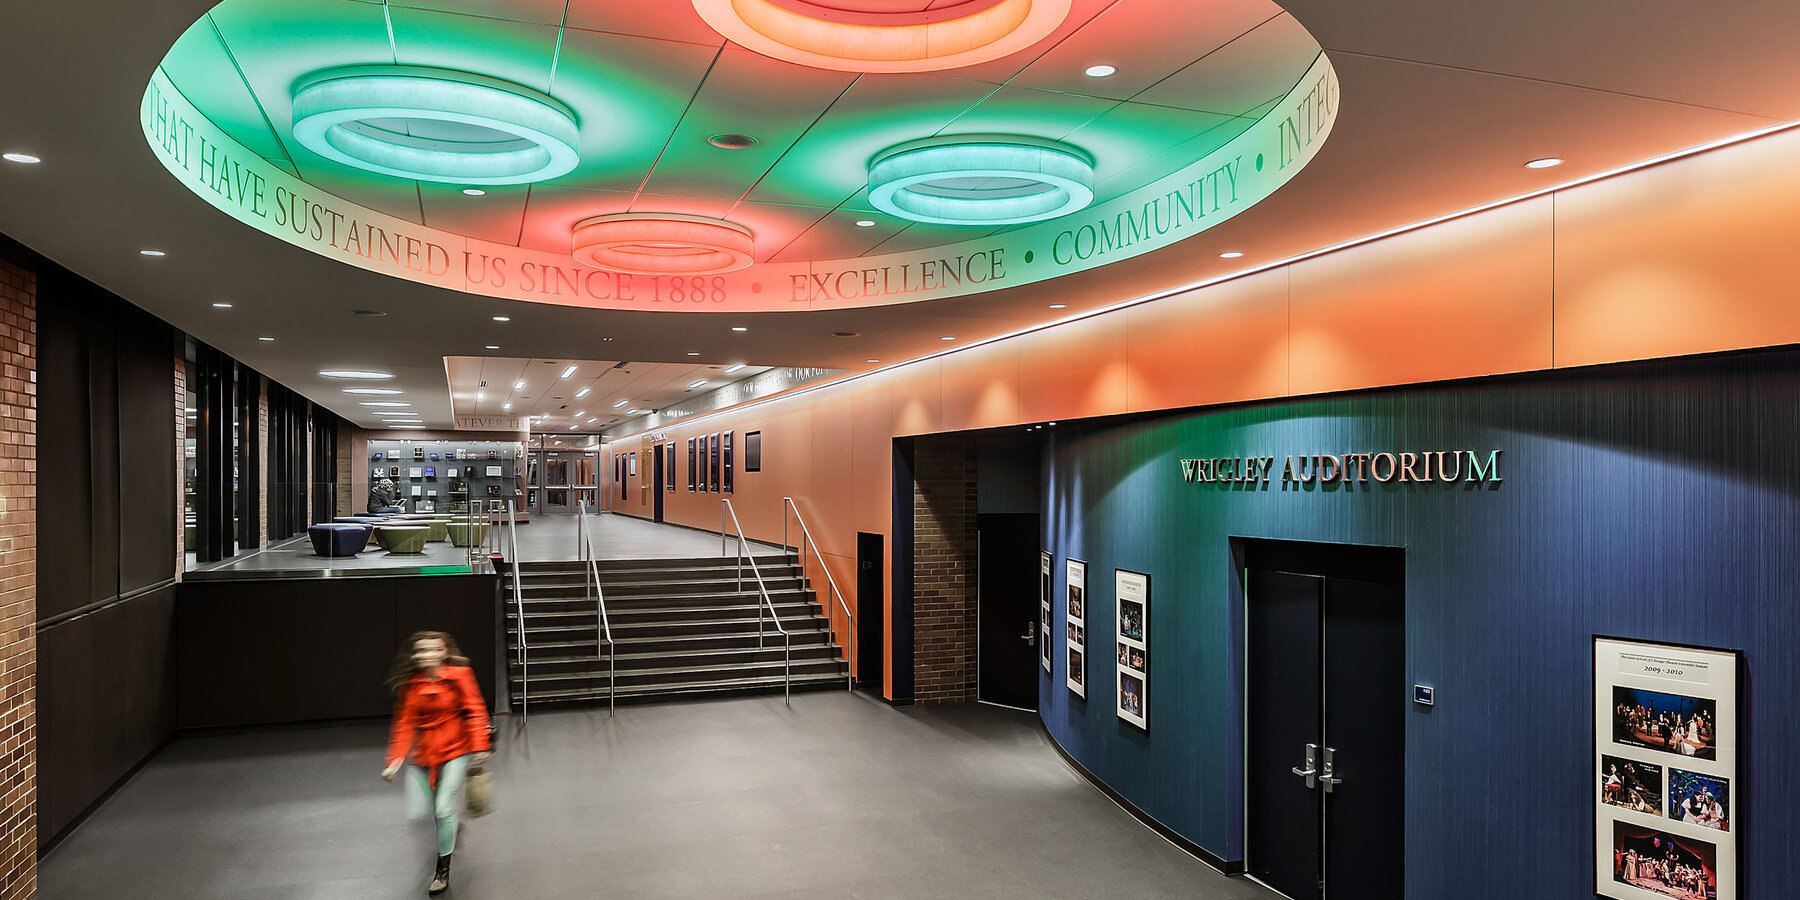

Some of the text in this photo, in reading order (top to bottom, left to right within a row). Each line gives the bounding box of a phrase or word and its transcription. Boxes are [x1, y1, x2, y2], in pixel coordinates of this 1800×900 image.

[149, 79, 194, 171] THAT
[200, 135, 267, 218] HAVE
[275, 186, 450, 277] SUSTAINED
[462, 250, 506, 288] US
[519, 261, 635, 301] SINCE
[651, 276, 727, 303] 1888
[789, 248, 1007, 303] EXCELLENCE
[1053, 155, 1242, 266] COMMUNITY
[1180, 449, 1504, 483] WRIGLEY AUDITORIUM
[1644, 665, 1661, 674] 2009
[1666, 668, 1683, 676] 2010
